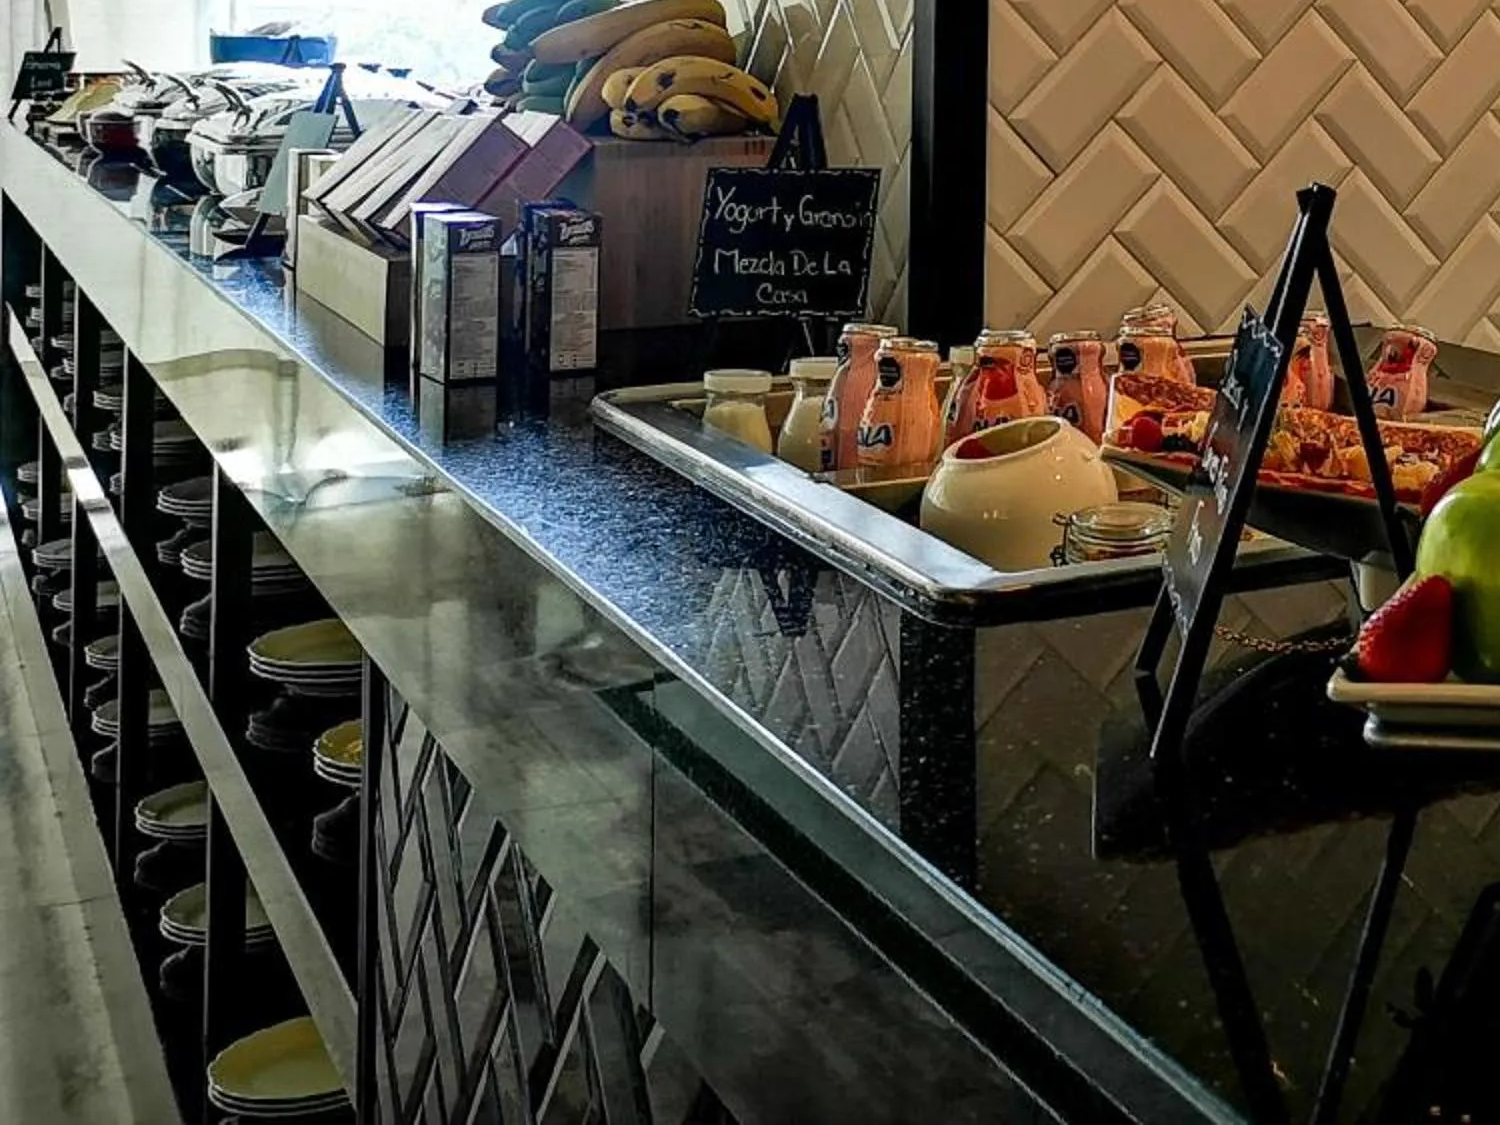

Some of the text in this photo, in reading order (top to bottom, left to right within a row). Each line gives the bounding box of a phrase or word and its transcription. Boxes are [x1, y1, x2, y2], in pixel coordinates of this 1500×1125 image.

[713, 186, 782, 233] Yogurt
[784, 213, 796, 232] y
[714, 248, 853, 276] Mezcla De La
[755, 282, 809, 304] Casa
